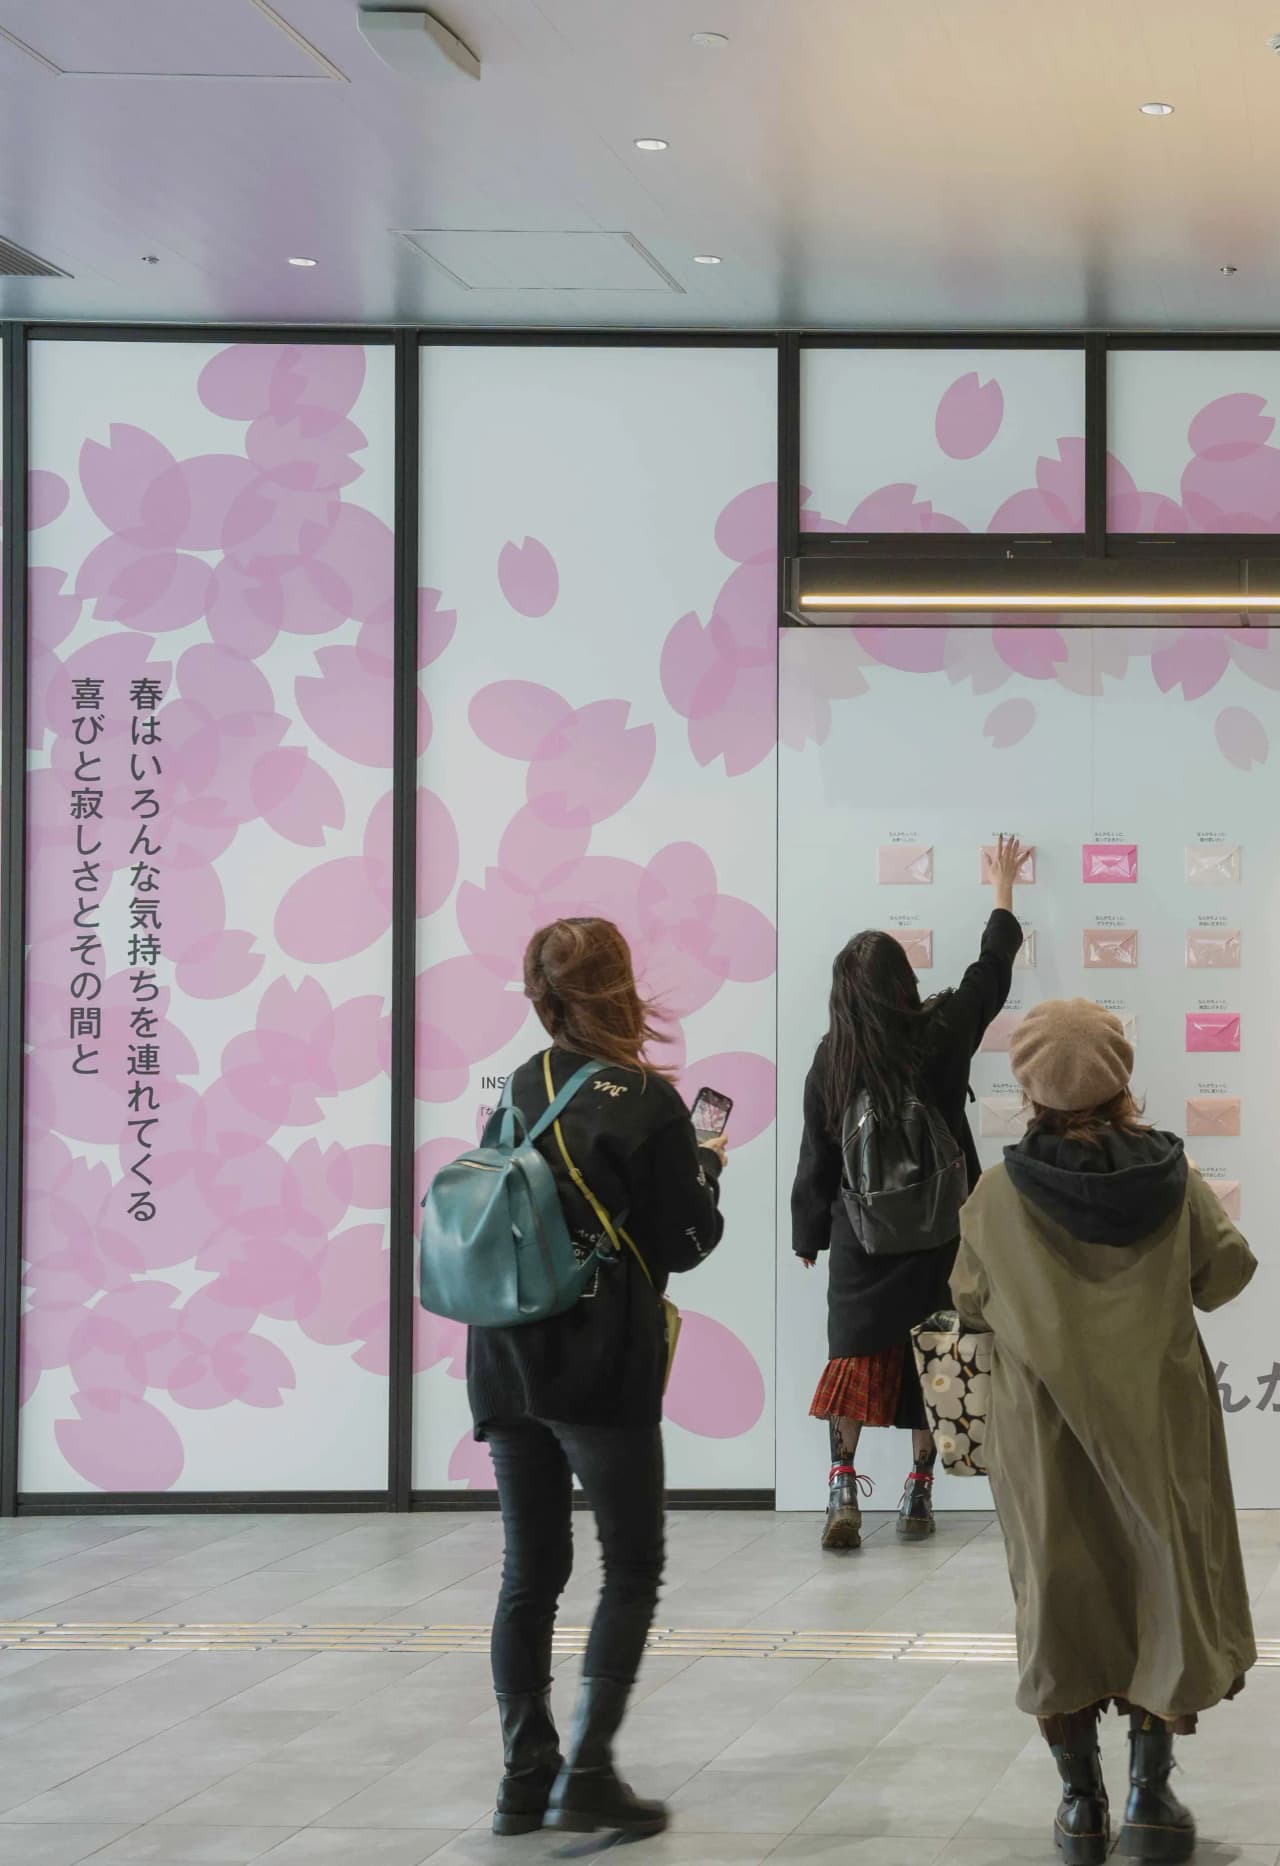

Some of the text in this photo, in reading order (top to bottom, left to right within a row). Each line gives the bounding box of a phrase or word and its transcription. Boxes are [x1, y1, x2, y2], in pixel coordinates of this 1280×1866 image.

[69, 677, 105, 1074] 喜びと寂しさとその間と
[127, 677, 163, 1221] 春はいろんな気持ちを連れてくる
[481, 1076, 510, 1089] INS
